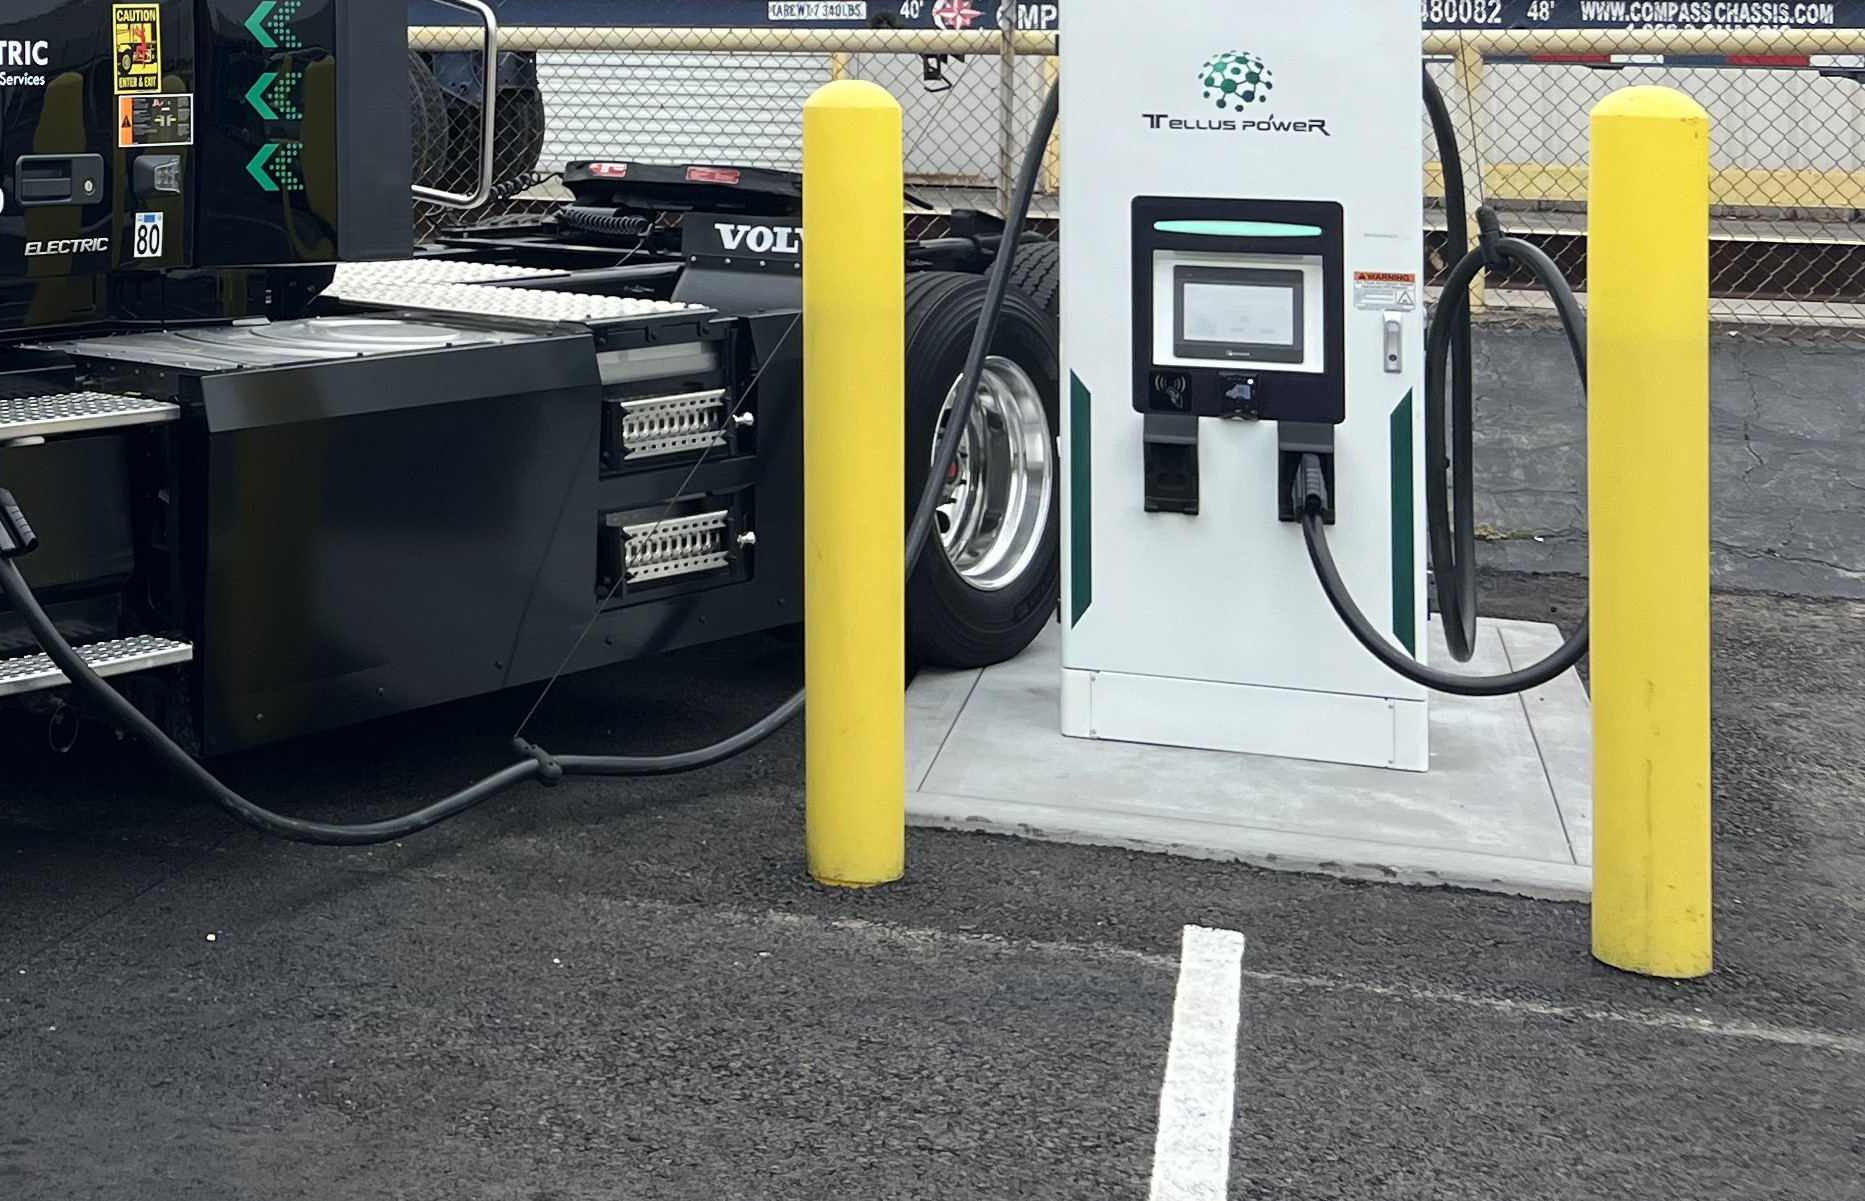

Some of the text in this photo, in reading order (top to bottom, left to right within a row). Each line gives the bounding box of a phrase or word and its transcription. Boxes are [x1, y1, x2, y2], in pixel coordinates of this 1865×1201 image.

[116, 10, 156, 22] CAUTION
[0, 72, 46, 88] Services
[24, 237, 109, 257] ELECTRIC
[136, 224, 160, 255] 80
[714, 223, 803, 254] VOL
